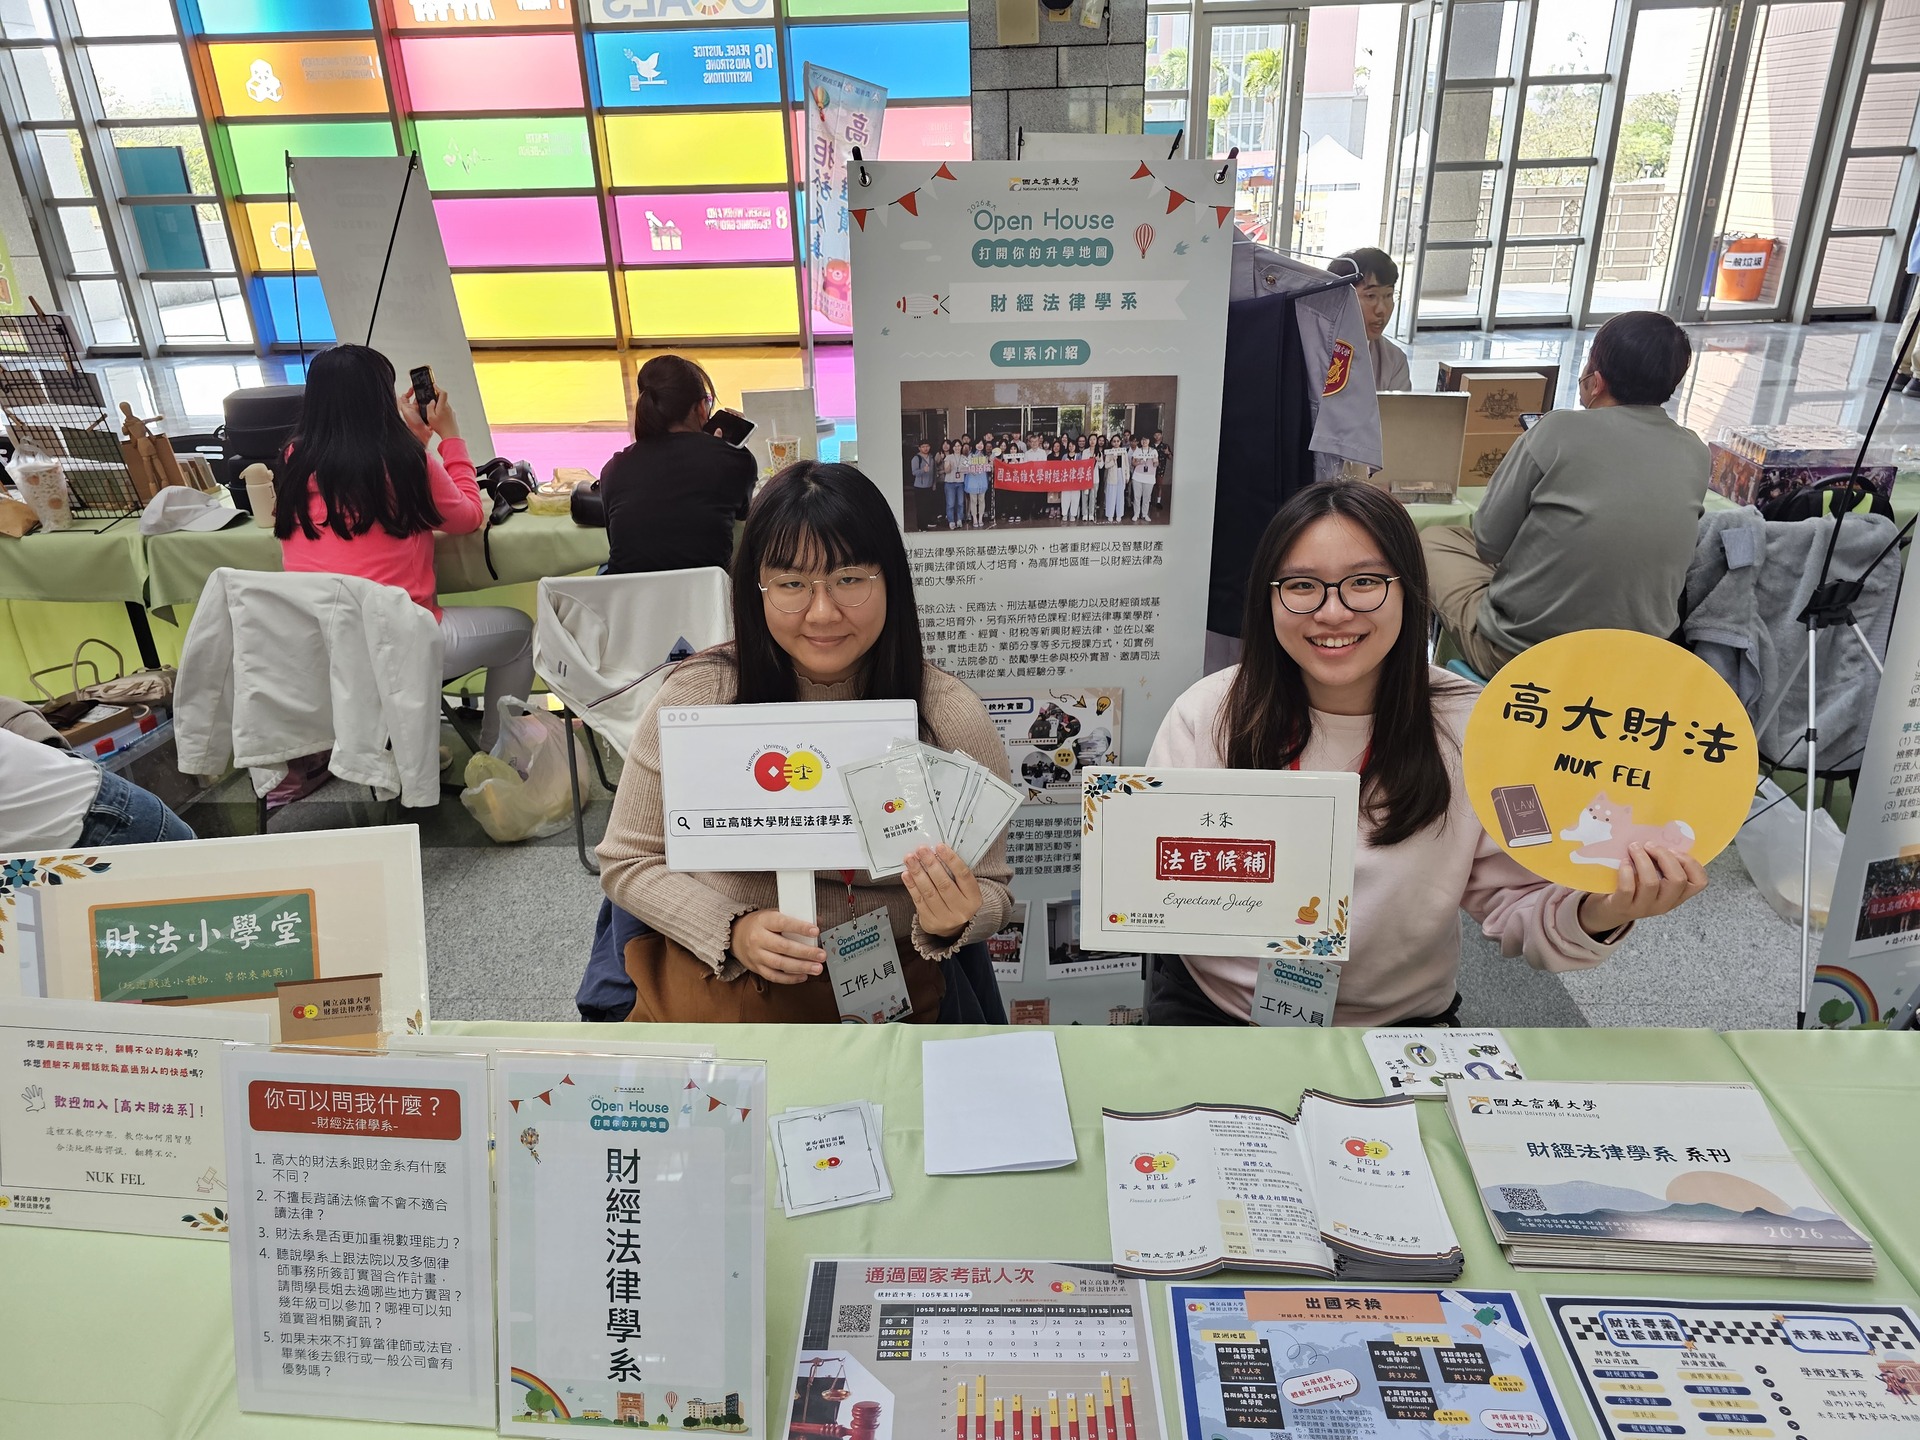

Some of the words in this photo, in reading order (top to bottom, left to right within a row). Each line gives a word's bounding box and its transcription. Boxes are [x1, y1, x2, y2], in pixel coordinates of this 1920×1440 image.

[974, 209, 1033, 234] Open
[1043, 208, 1114, 231] House
[979, 246, 1108, 261] 打開你的升學地圖
[990, 292, 1138, 313] 財經法律學系
[1002, 346, 1079, 361] 學系介紹
[913, 576, 986, 588] 業的大學系所。
[1502, 682, 1738, 764] 高大財法
[745, 748, 761, 773] National
[763, 744, 791, 758] University
[808, 744, 831, 769] Kaohsiung
[1554, 753, 1603, 780] NUK
[1612, 764, 1651, 790] FEL
[1512, 796, 1536, 812] LAW
[703, 814, 853, 830] 國立高雄大學財經法律學系
[1163, 848, 1268, 874] 法官候補
[1162, 892, 1220, 908] Expectant
[1222, 893, 1263, 913] Judge
[105, 911, 302, 959] 財法小學堂
[838, 934, 856, 946] Open
[857, 924, 878, 937] House
[840, 960, 896, 998] 工作人員
[1276, 960, 1296, 971] Open
[1299, 966, 1324, 980] House
[1260, 996, 1324, 1028] 工作人員
[264, 1088, 440, 1118] 你可以問我什麼？
[591, 1098, 624, 1114] Open
[629, 1100, 669, 1114] House
[1492, 1098, 1597, 1111] 國立高雄大學
[312, 1116, 398, 1132] -財經法律學系-
[594, 1118, 666, 1129] 打開你的升學地圖
[1525, 1110, 1556, 1118] University
[1567, 1112, 1600, 1120] Kaohsiung
[1526, 1142, 1678, 1164] 財經法律學系
[1686, 1146, 1730, 1164] 系刊
[254, 1152, 266, 1165] 1.
[272, 1153, 447, 1175] 高大的財法系跟財金系有什麼
[1356, 1158, 1380, 1167] FEL
[86, 1170, 114, 1184] NUK
[120, 1173, 145, 1186] FEL
[272, 1168, 309, 1184] 不同？
[1146, 1174, 1168, 1182] FEL
[256, 1190, 267, 1203] 2.
[273, 1190, 448, 1212] 不擅長背誦法條會不會不適合
[274, 1206, 324, 1221] 讀法律？
[258, 1226, 269, 1240] 3.
[276, 1227, 460, 1250] 財法系是否更加重視數理能力？
[1764, 1226, 1823, 1240] 2026
[258, 1247, 270, 1260] 4.
[276, 1248, 450, 1270] 聽說學系上跟法院以及多個律
[606, 1148, 642, 1383] 財經法律學系
[865, 1266, 1036, 1285] 通過國家考試人次
[278, 1280, 462, 1302] 請問學長姐去過哪些地方實習？
[278, 1296, 452, 1318] 幾年級可以參加？哪裡可以知
[1306, 1297, 1382, 1310] 出國交換
[280, 1312, 382, 1329] 道實習相關資訊？
[1608, 1318, 1676, 1330] 財法專業
[263, 1331, 274, 1344] 5.
[1614, 1330, 1682, 1342] 選修課程
[1792, 1330, 1860, 1342] 未來出路
[281, 1348, 454, 1371] 畢業後去銀行或一般公司會有
[282, 1362, 331, 1378] 優勢嗎？
